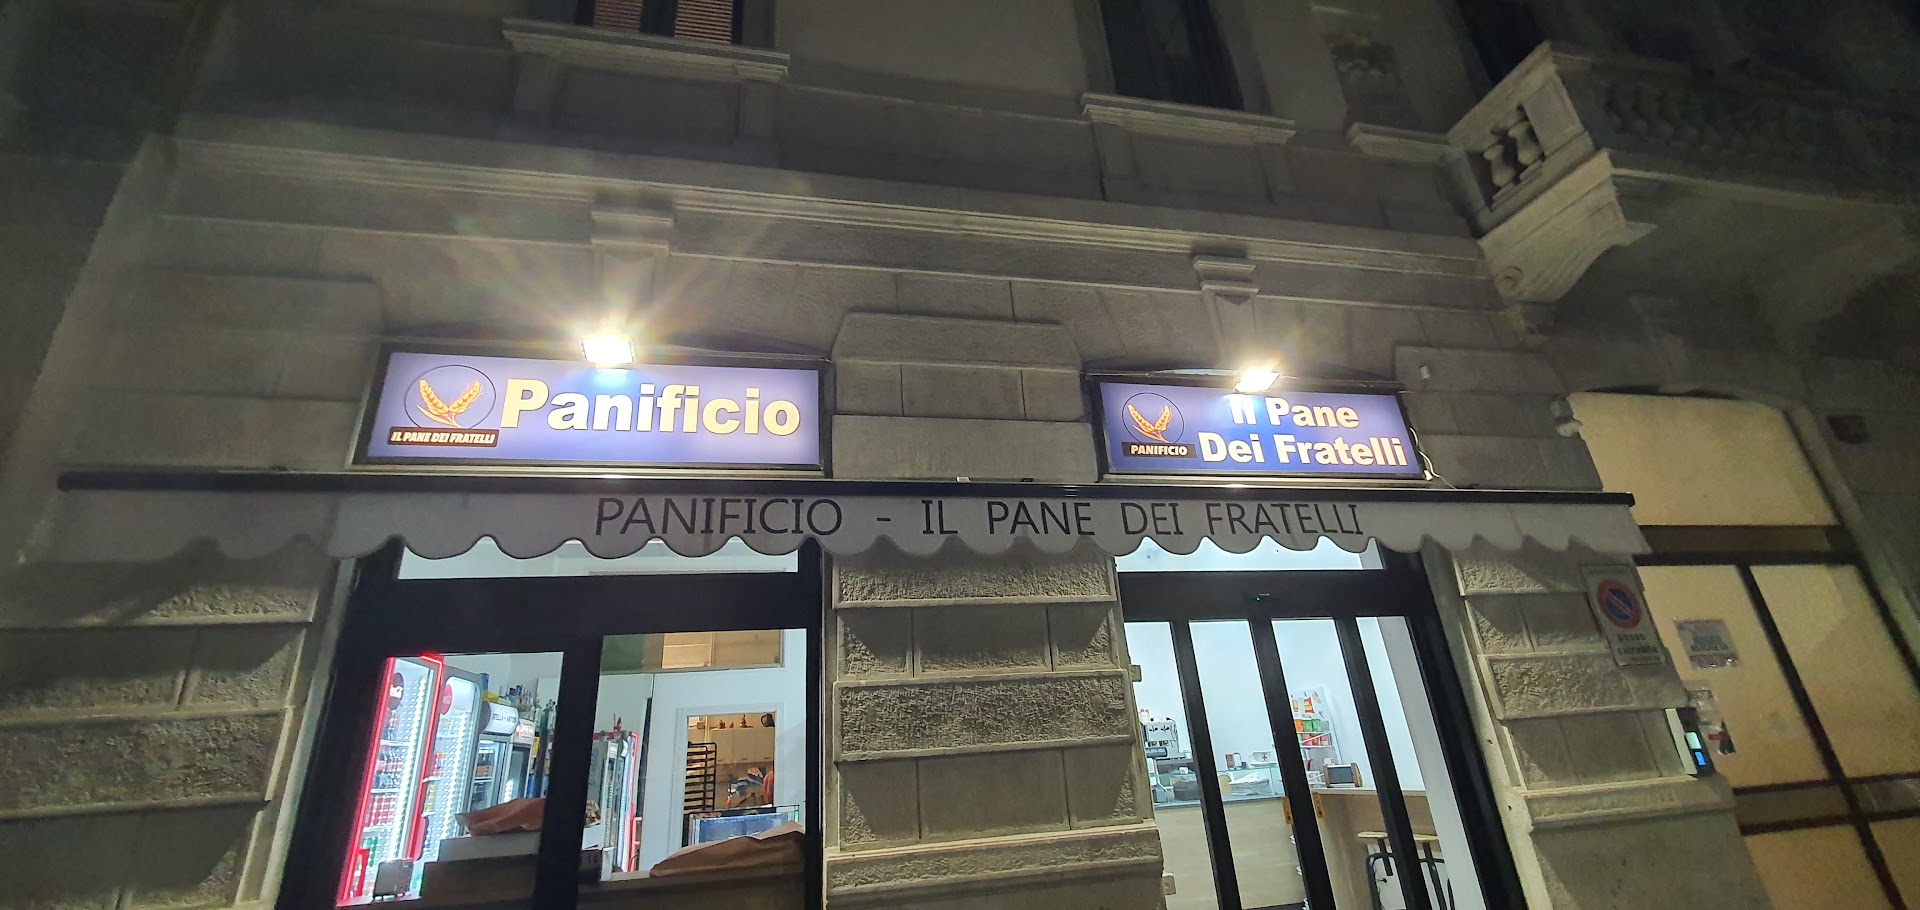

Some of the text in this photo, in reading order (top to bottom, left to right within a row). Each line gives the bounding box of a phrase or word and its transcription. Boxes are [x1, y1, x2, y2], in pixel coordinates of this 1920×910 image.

[500, 378, 801, 436] Panificio
[1264, 396, 1360, 428] Pane
[390, 431, 496, 444] IL PANE DEI FRATELLI
[1130, 444, 1188, 456] PANIFICIO
[1197, 432, 1409, 466] Dei Fratelli
[595, 497, 842, 536] PANIFICIO
[921, 499, 959, 535] IL
[987, 500, 1095, 535] PANE
[1121, 501, 1184, 535] DEI
[1206, 502, 1363, 535] FRATELLI
